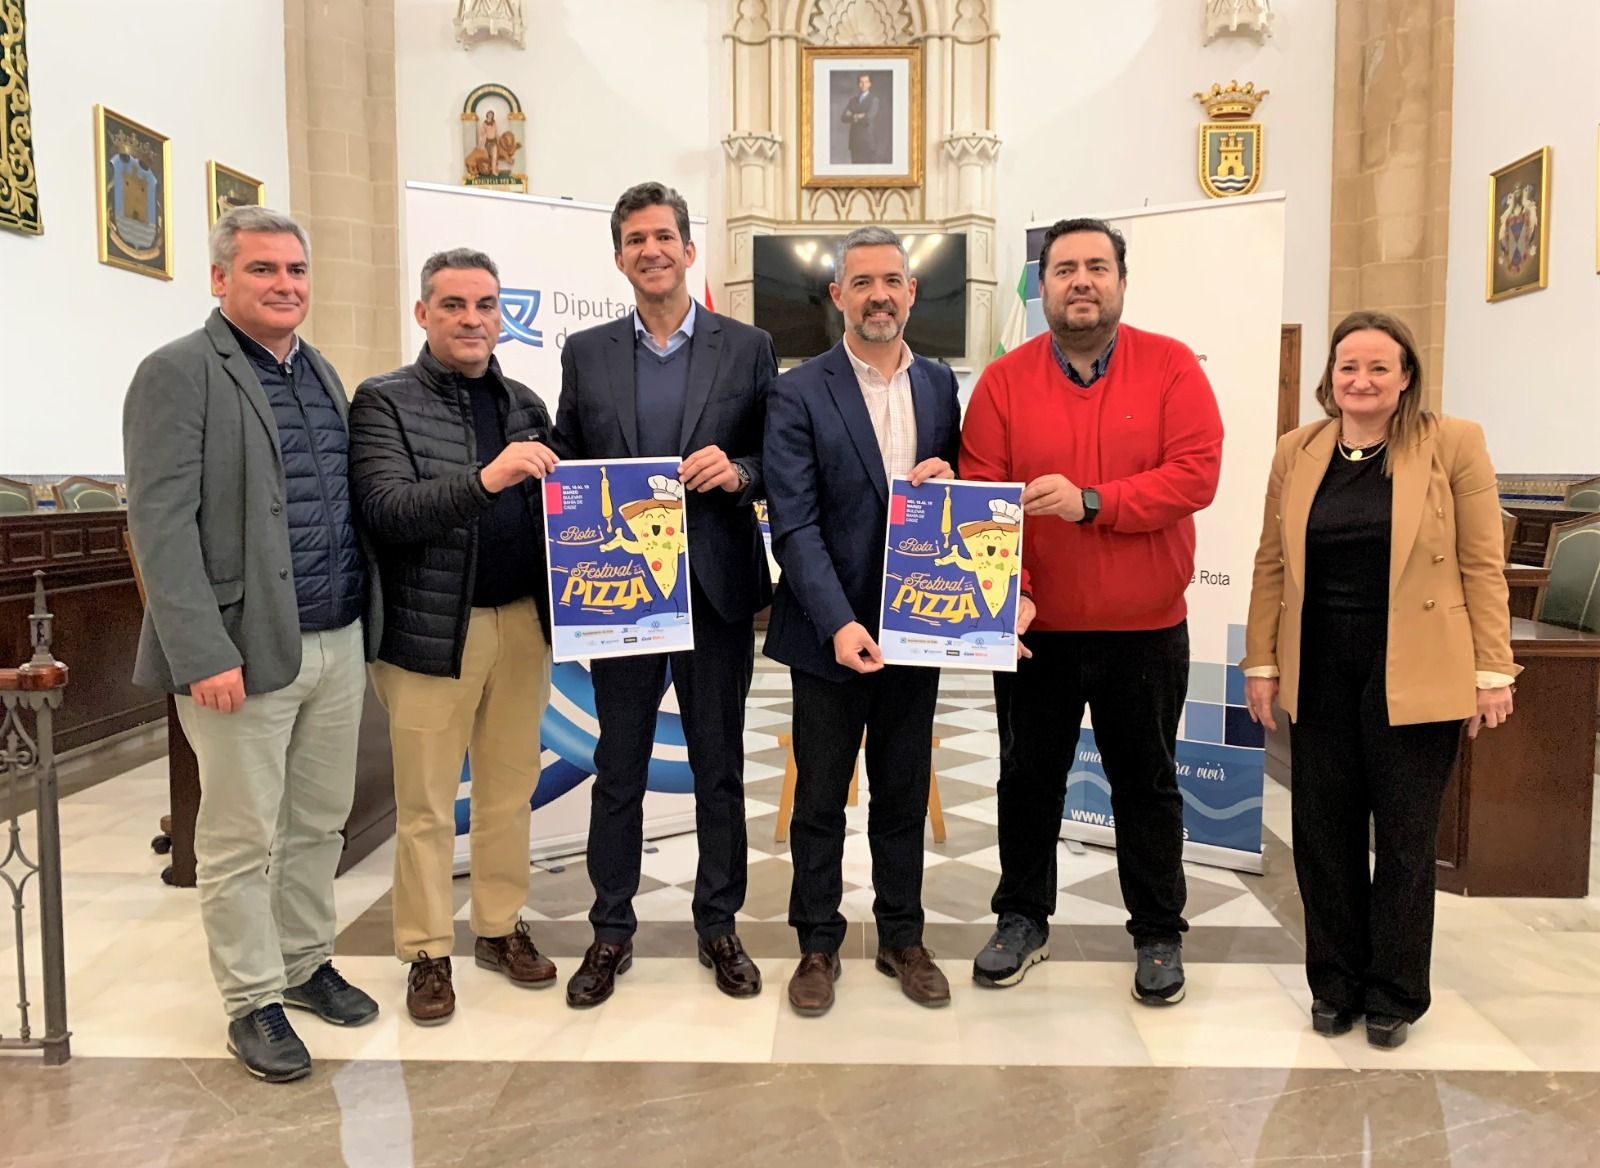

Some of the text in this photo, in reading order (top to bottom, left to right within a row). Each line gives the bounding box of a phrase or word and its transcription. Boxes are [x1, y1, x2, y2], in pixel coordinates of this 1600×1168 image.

[560, 526, 597, 541] Rota
[898, 537, 934, 552] Rota
[571, 559, 633, 579] Festival
[1200, 570, 1230, 585] Rota
[903, 572, 966, 591] Festival
[560, 576, 653, 610] PIZZA
[891, 585, 980, 624] PIZZA
[1196, 761, 1227, 781] vivir
[1071, 808, 1115, 827] www.a
